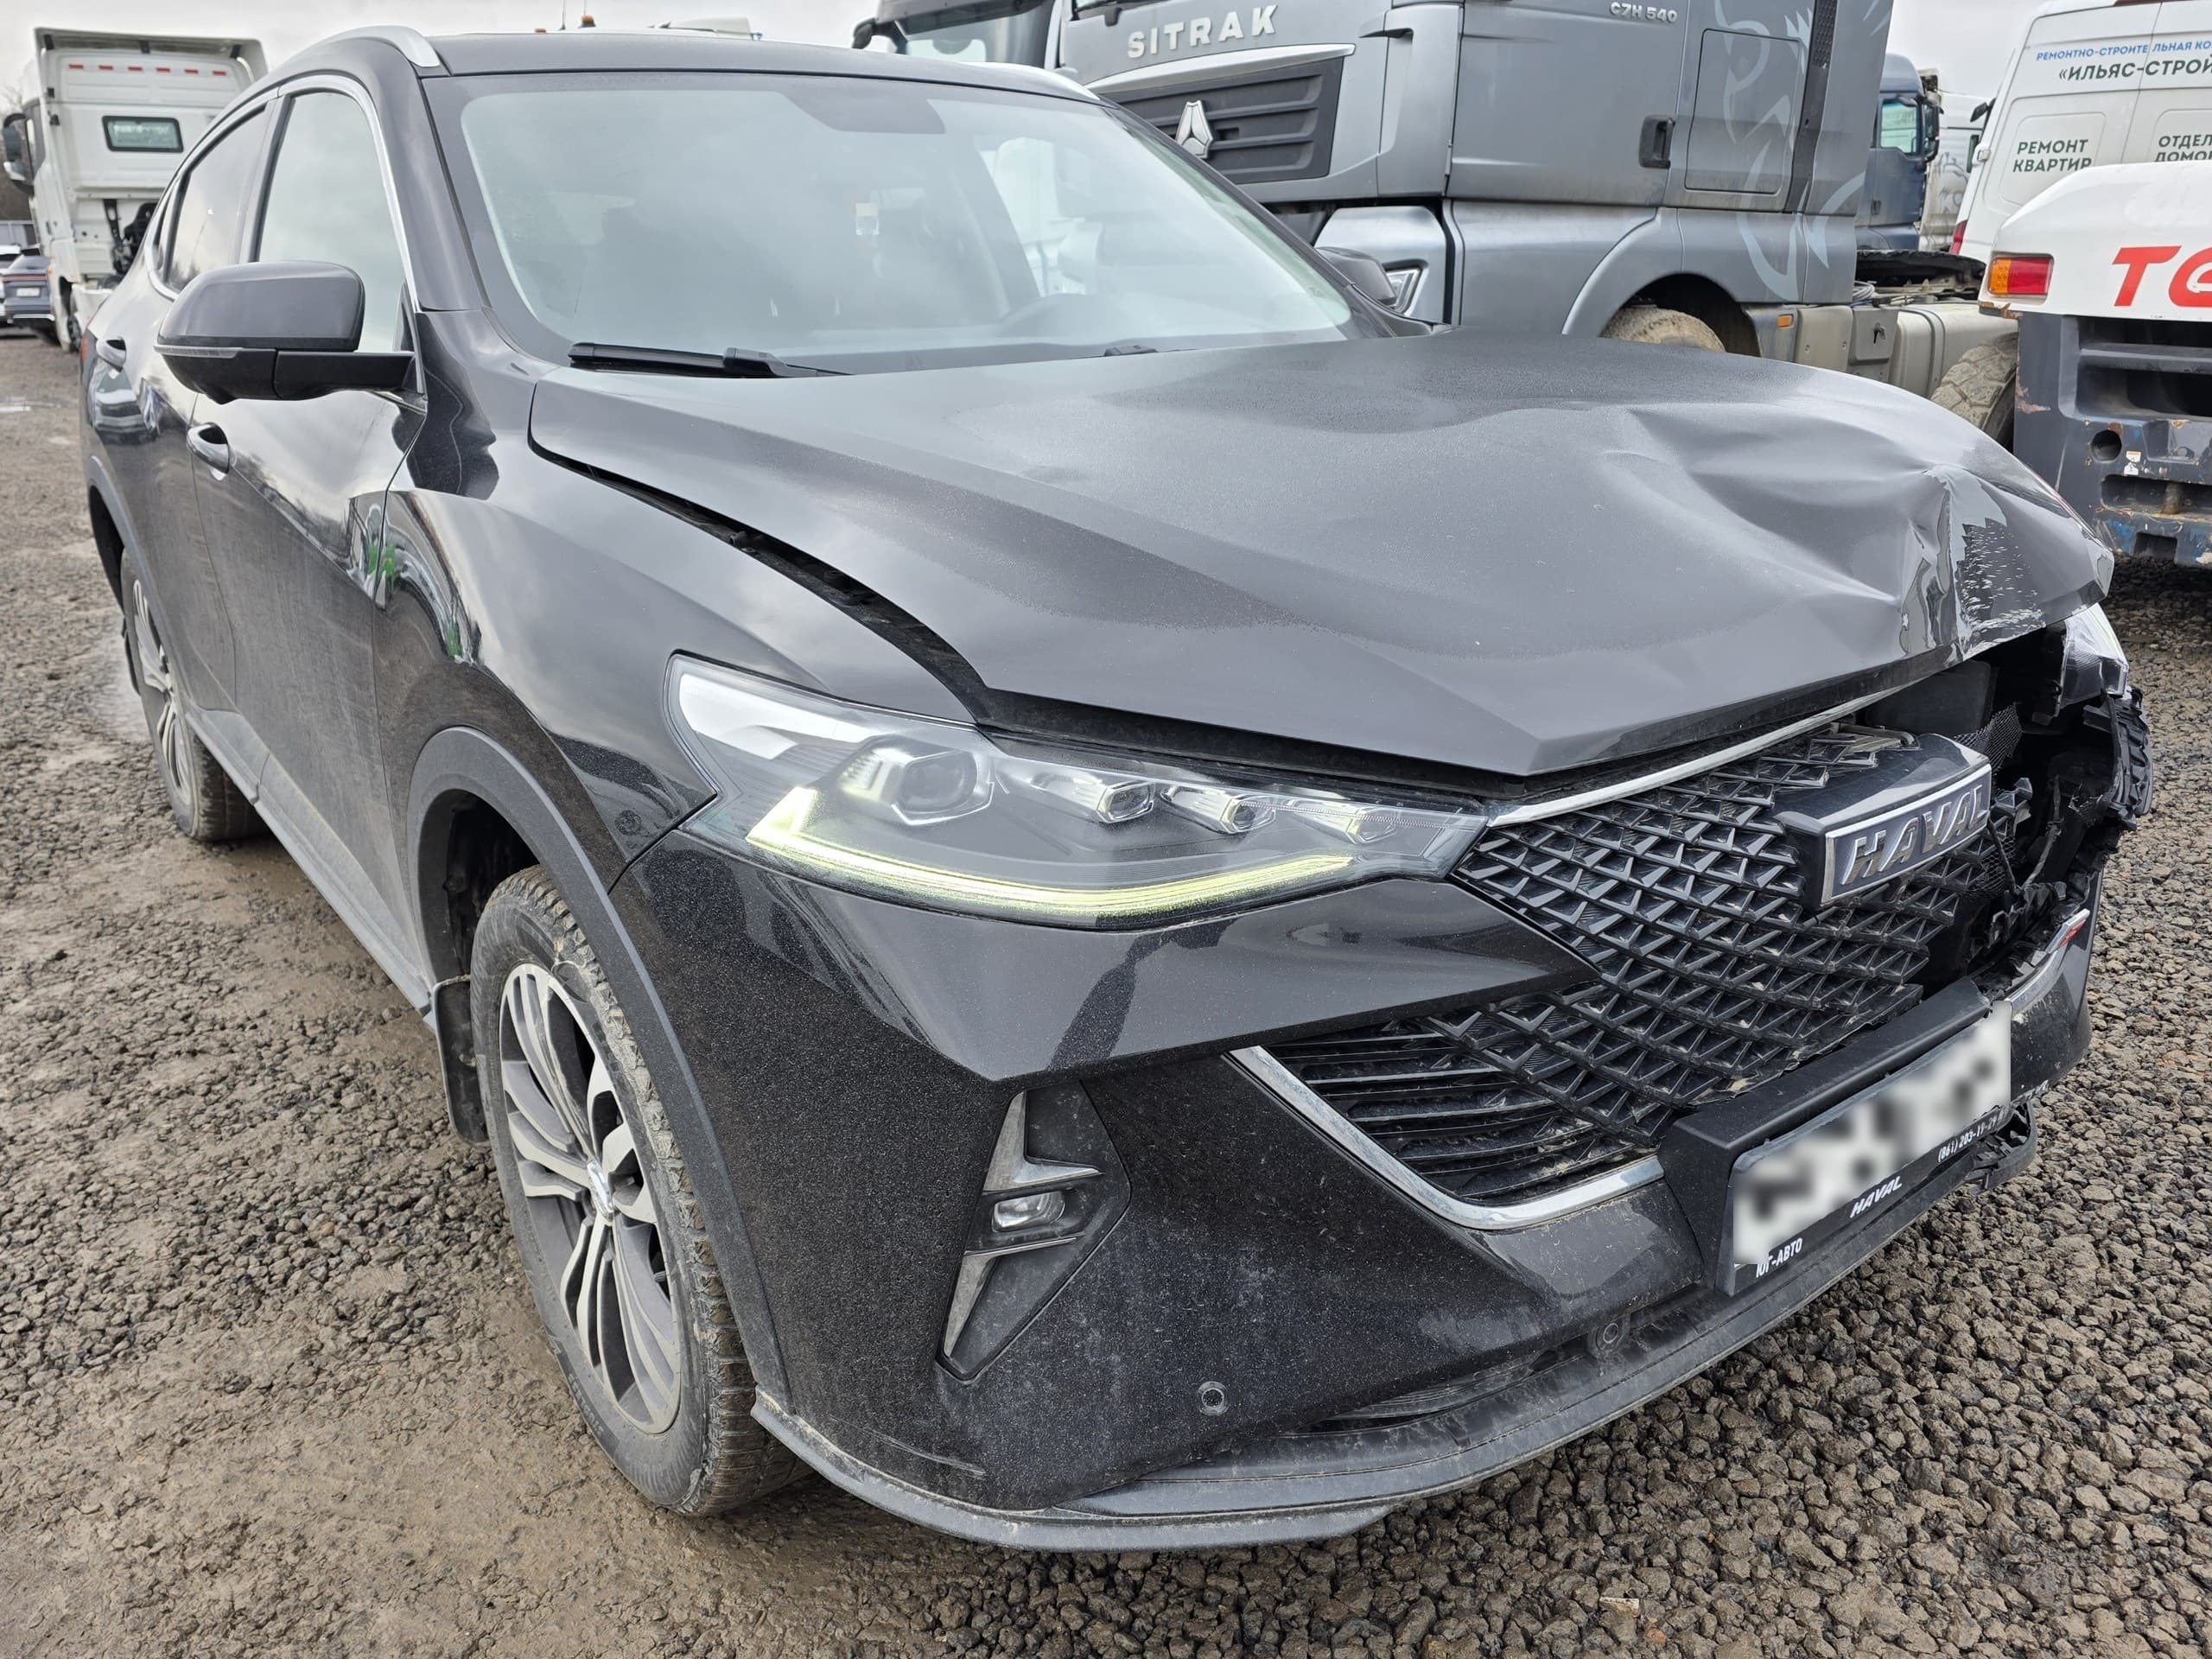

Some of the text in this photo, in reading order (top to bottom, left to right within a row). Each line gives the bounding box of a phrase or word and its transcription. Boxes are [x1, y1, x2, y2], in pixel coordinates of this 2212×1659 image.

[1610, 2, 1678, 22] C7H 540
[1128, 4, 1278, 59] SITRAK
[2017, 138, 2088, 155] РЕМОНТ
[2155, 150, 2212, 162] ДОМО
[2012, 157, 2092, 173] КВАРТИР
[1840, 784, 1988, 886] HAVAL
[1850, 1175, 1903, 1218] HAVAL
